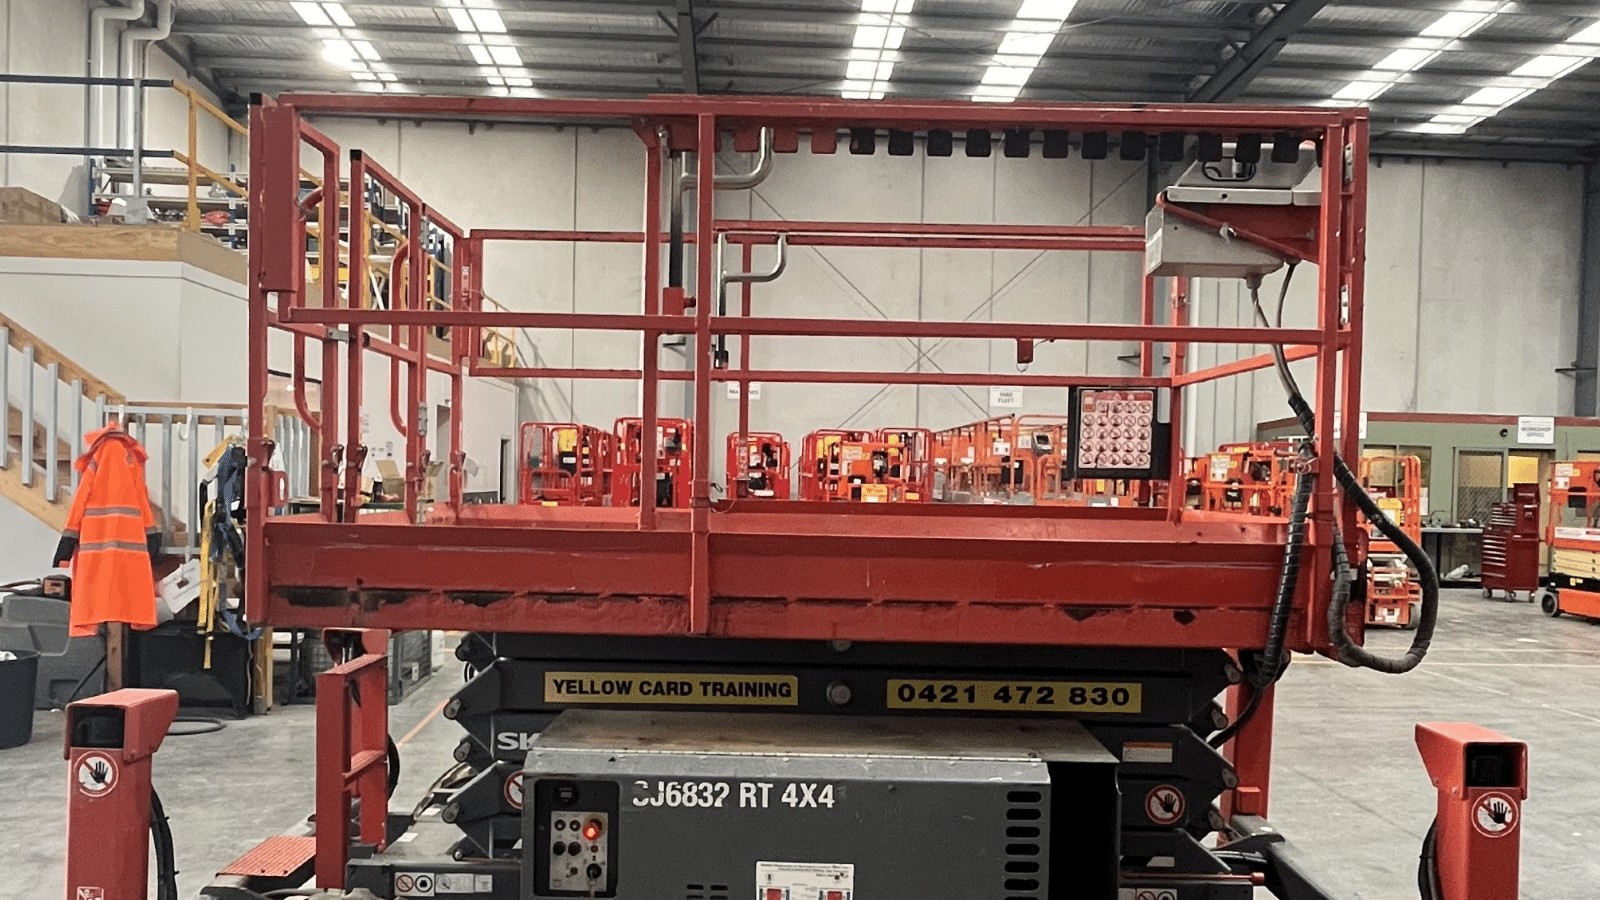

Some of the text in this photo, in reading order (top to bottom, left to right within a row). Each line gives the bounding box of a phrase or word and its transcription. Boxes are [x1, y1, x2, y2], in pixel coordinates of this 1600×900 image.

[553, 679, 792, 697] YELLOW CARD TRAINING
[897, 683, 1130, 706] 0421 472 830
[739, 782, 774, 808] RT
[781, 783, 835, 808] 4X4
